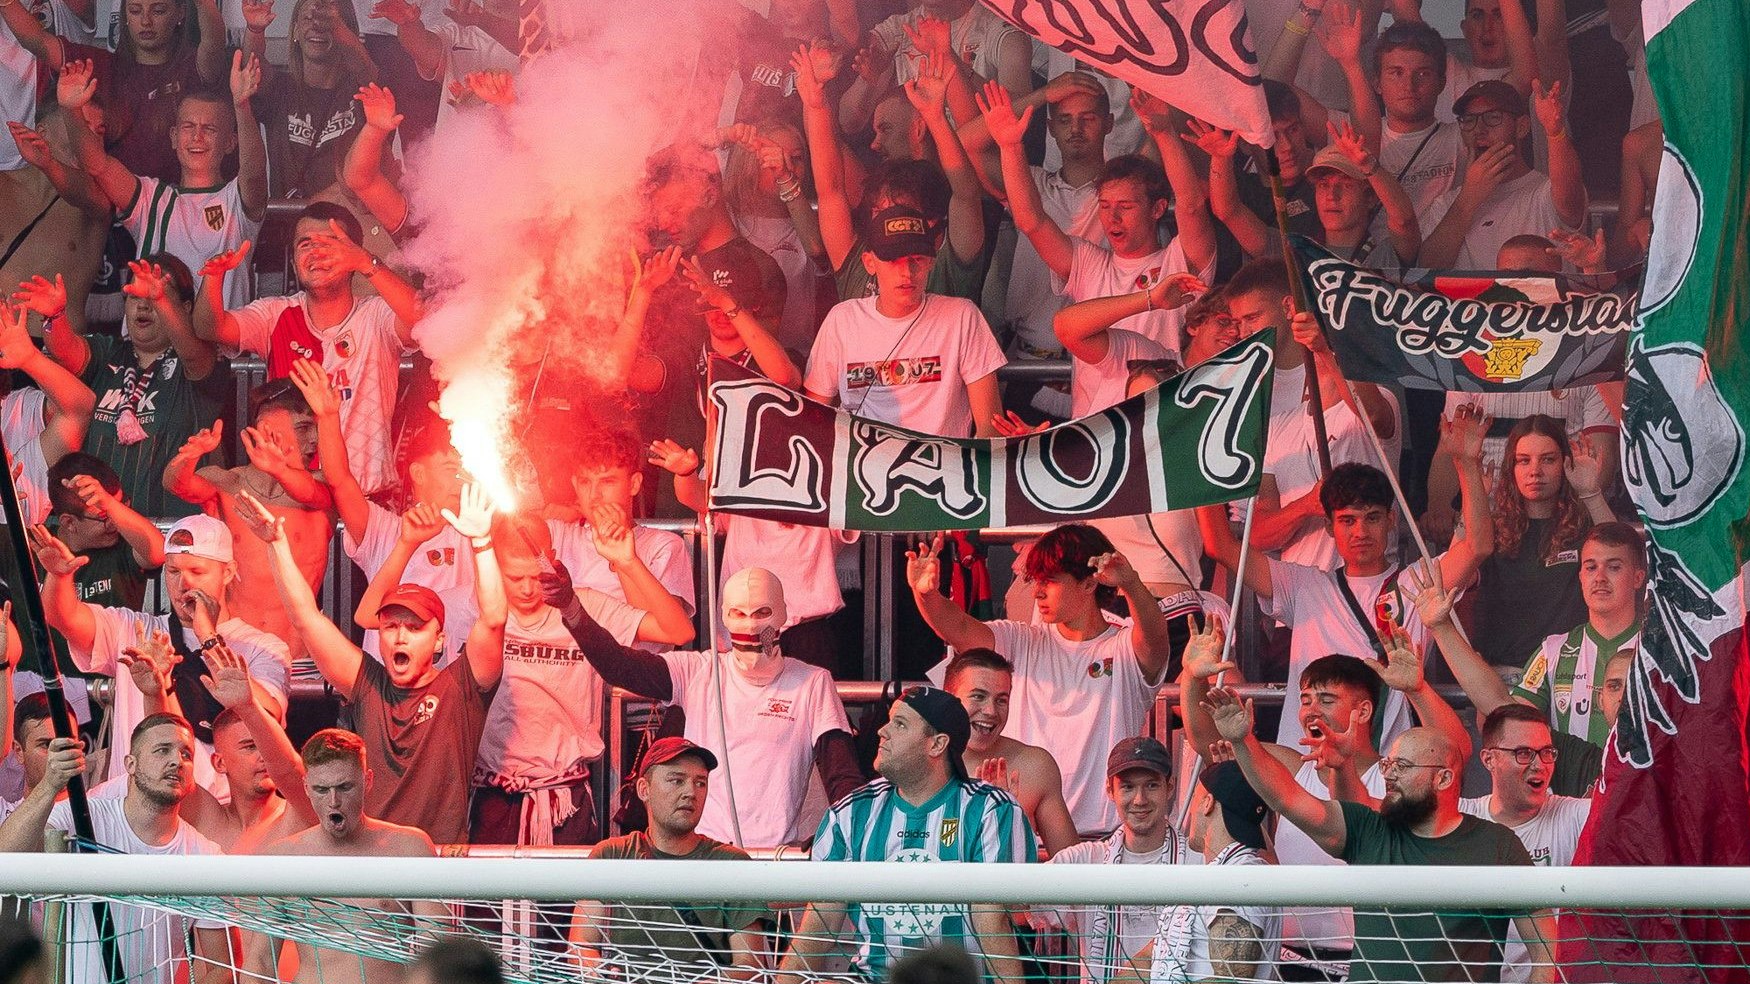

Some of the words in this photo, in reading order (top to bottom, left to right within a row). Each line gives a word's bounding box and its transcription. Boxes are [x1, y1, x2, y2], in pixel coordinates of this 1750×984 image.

[504, 643, 585, 662] SBURG
[897, 829, 931, 839] adidas
[870, 904, 965, 916] USTENA
